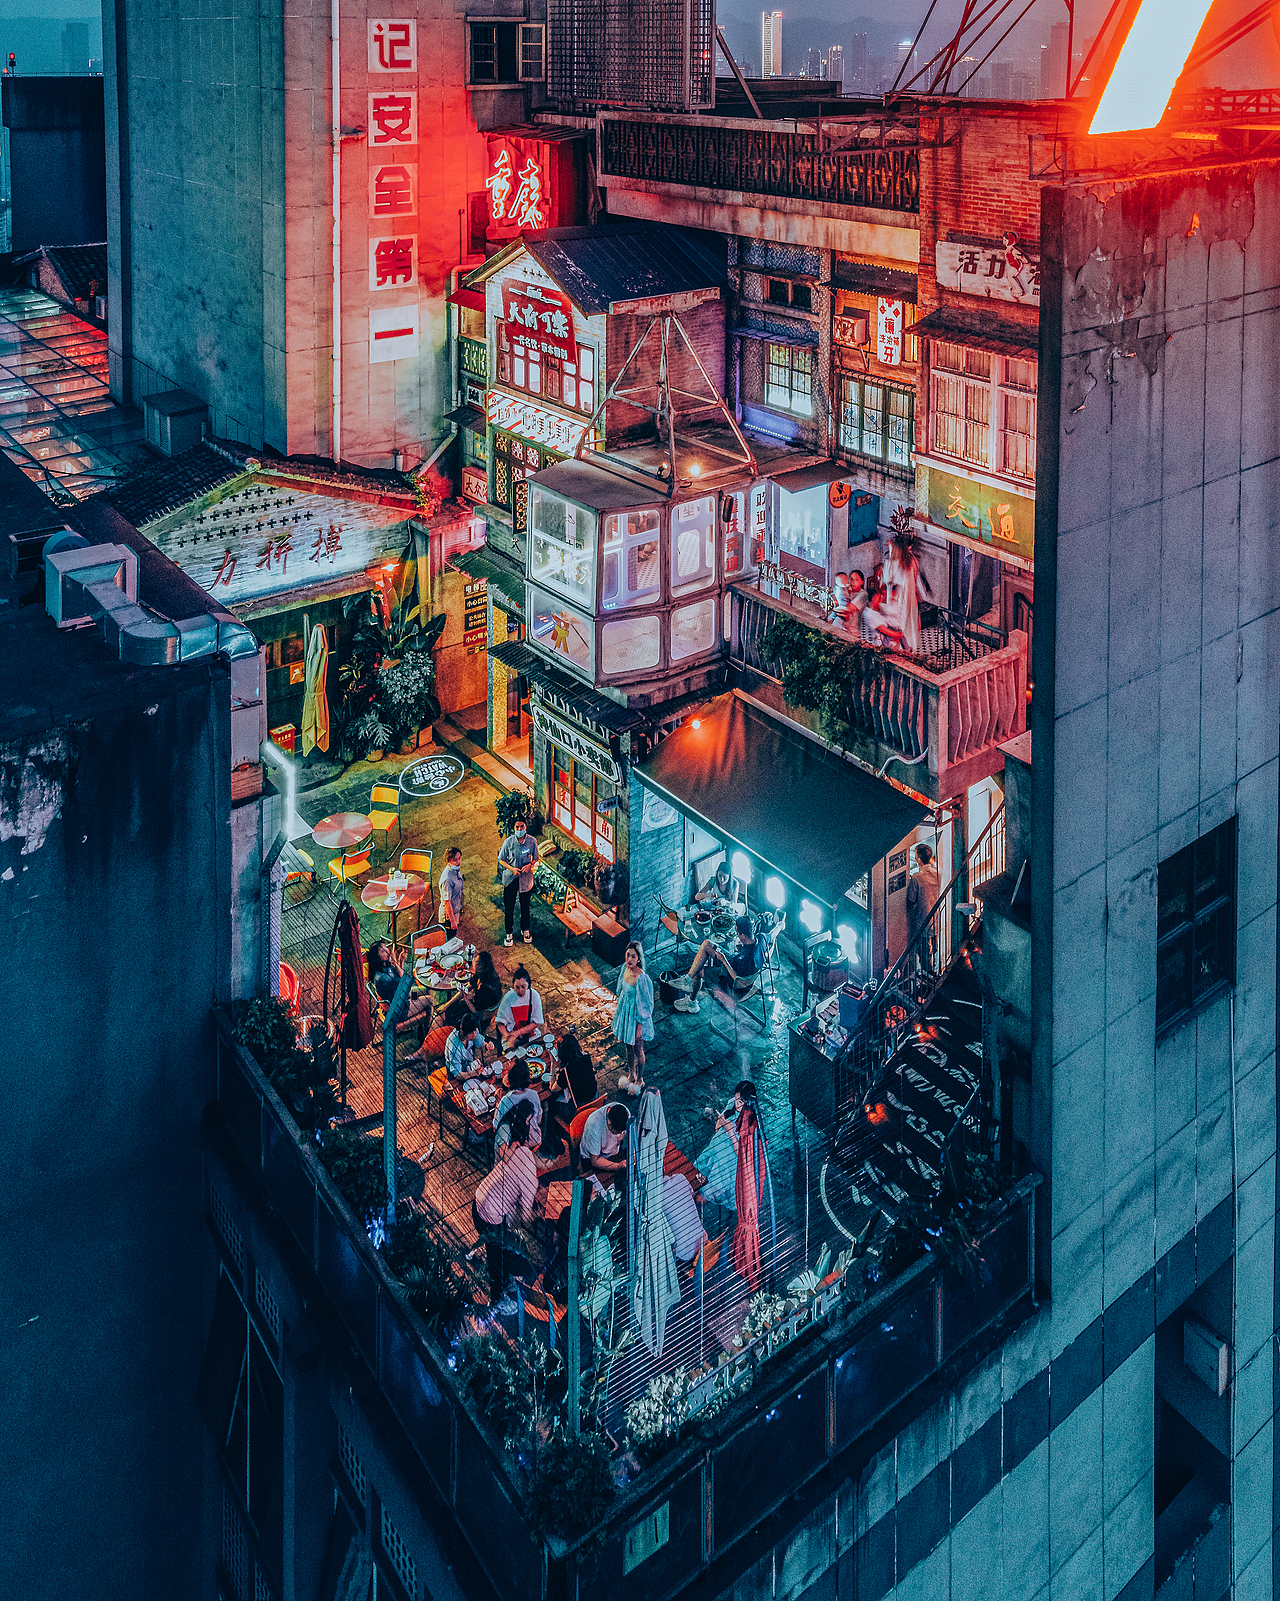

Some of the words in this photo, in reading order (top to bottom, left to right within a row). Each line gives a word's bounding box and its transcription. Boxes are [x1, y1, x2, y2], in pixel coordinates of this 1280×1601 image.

[373, 24, 414, 340] 记安全第一
[414, 761, 448, 777] WATCH
